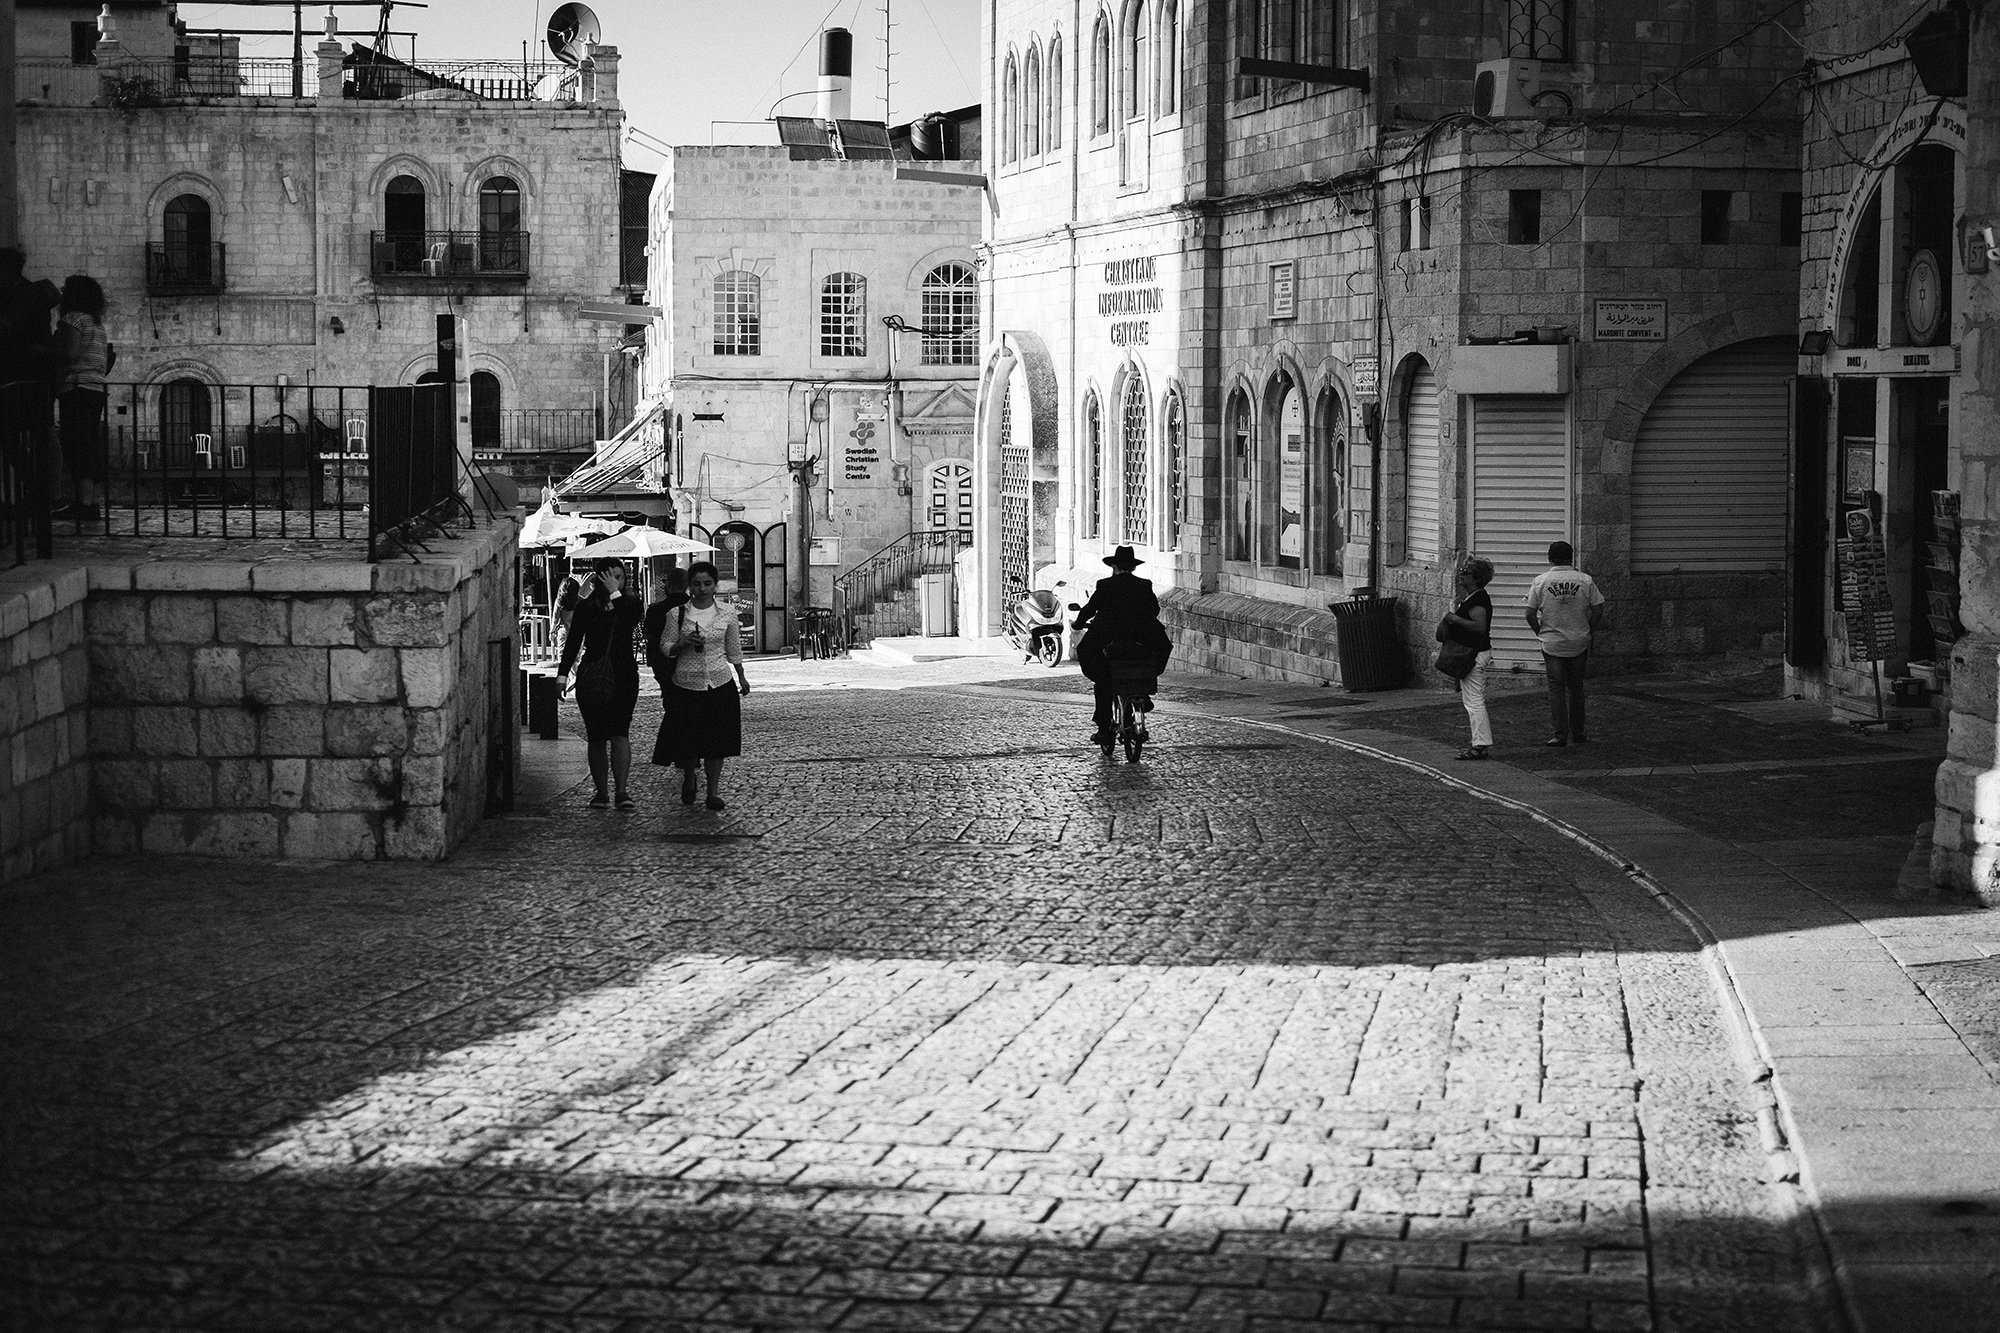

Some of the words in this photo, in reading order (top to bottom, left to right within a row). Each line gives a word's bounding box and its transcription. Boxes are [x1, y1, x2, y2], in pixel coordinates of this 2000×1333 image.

[1104, 257, 1157, 285] CHRISTIAN
[1098, 287, 1164, 317] INFORMATION
[1110, 320, 1149, 347] CENTRE
[1598, 329, 1625, 337] MARONITE
[1627, 329, 1652, 337] CONVENT
[1846, 356, 1861, 367] BOOKS
[319, 452, 369, 460] WELCO
[474, 452, 504, 460] CITY
[845, 447, 877, 455] Swedish
[845, 464, 868, 473] Study
[1547, 582, 1580, 595] GENOVA
